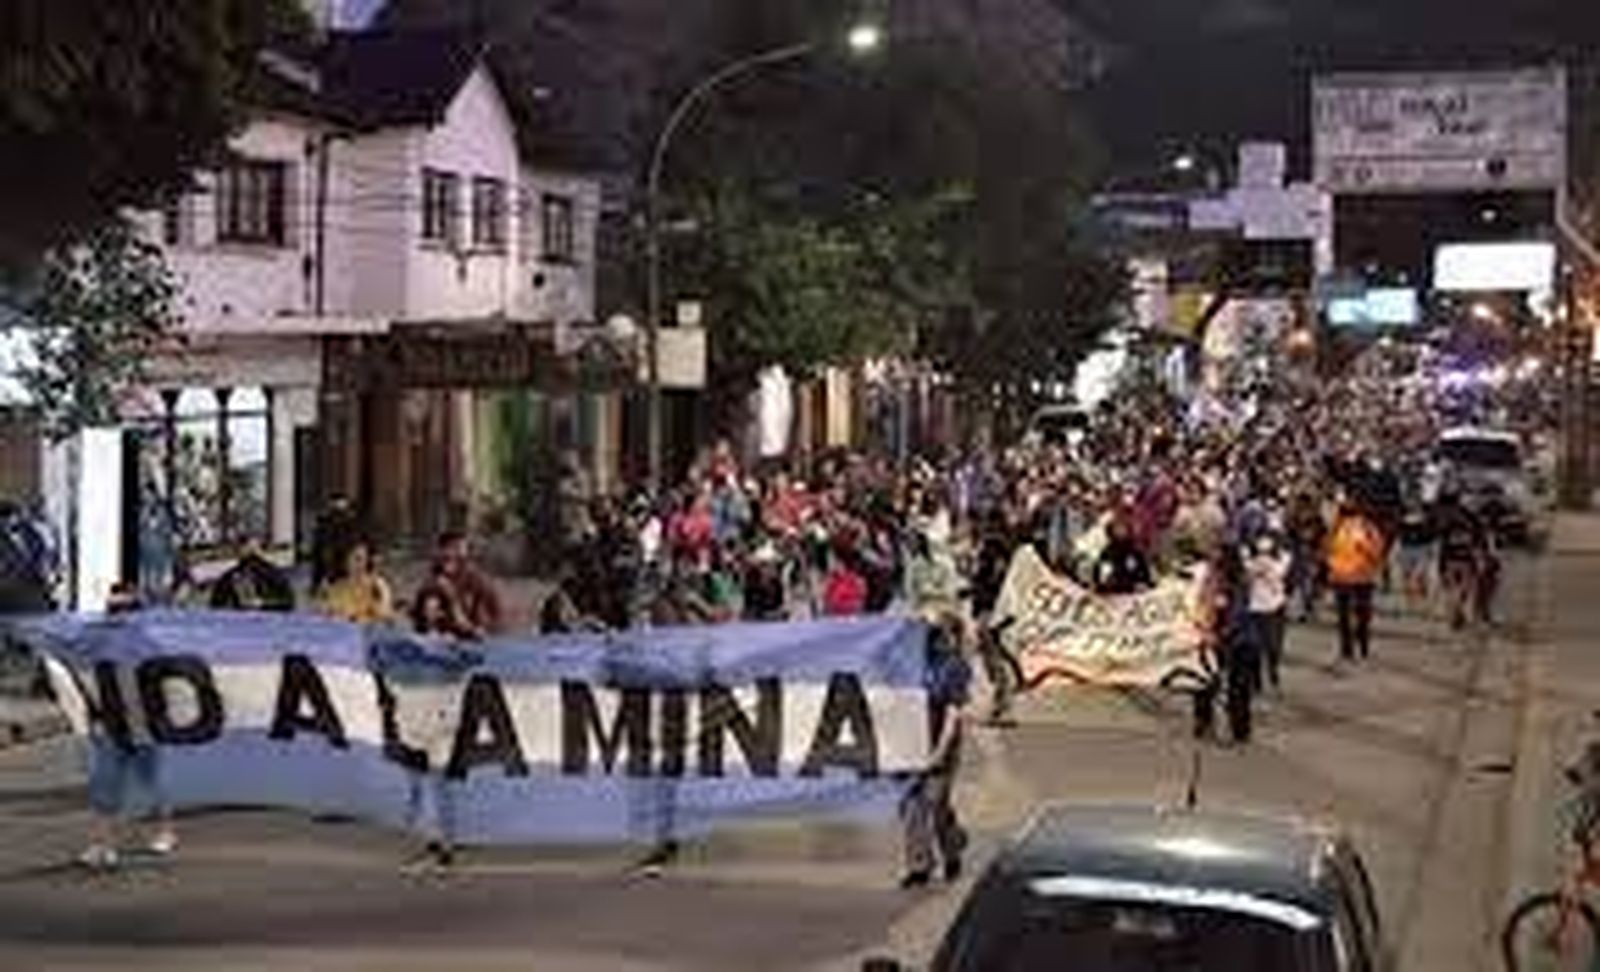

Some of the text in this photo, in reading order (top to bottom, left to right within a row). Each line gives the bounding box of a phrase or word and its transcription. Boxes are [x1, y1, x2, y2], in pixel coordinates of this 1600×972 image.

[58, 653, 881, 780] NO A LA MINA
